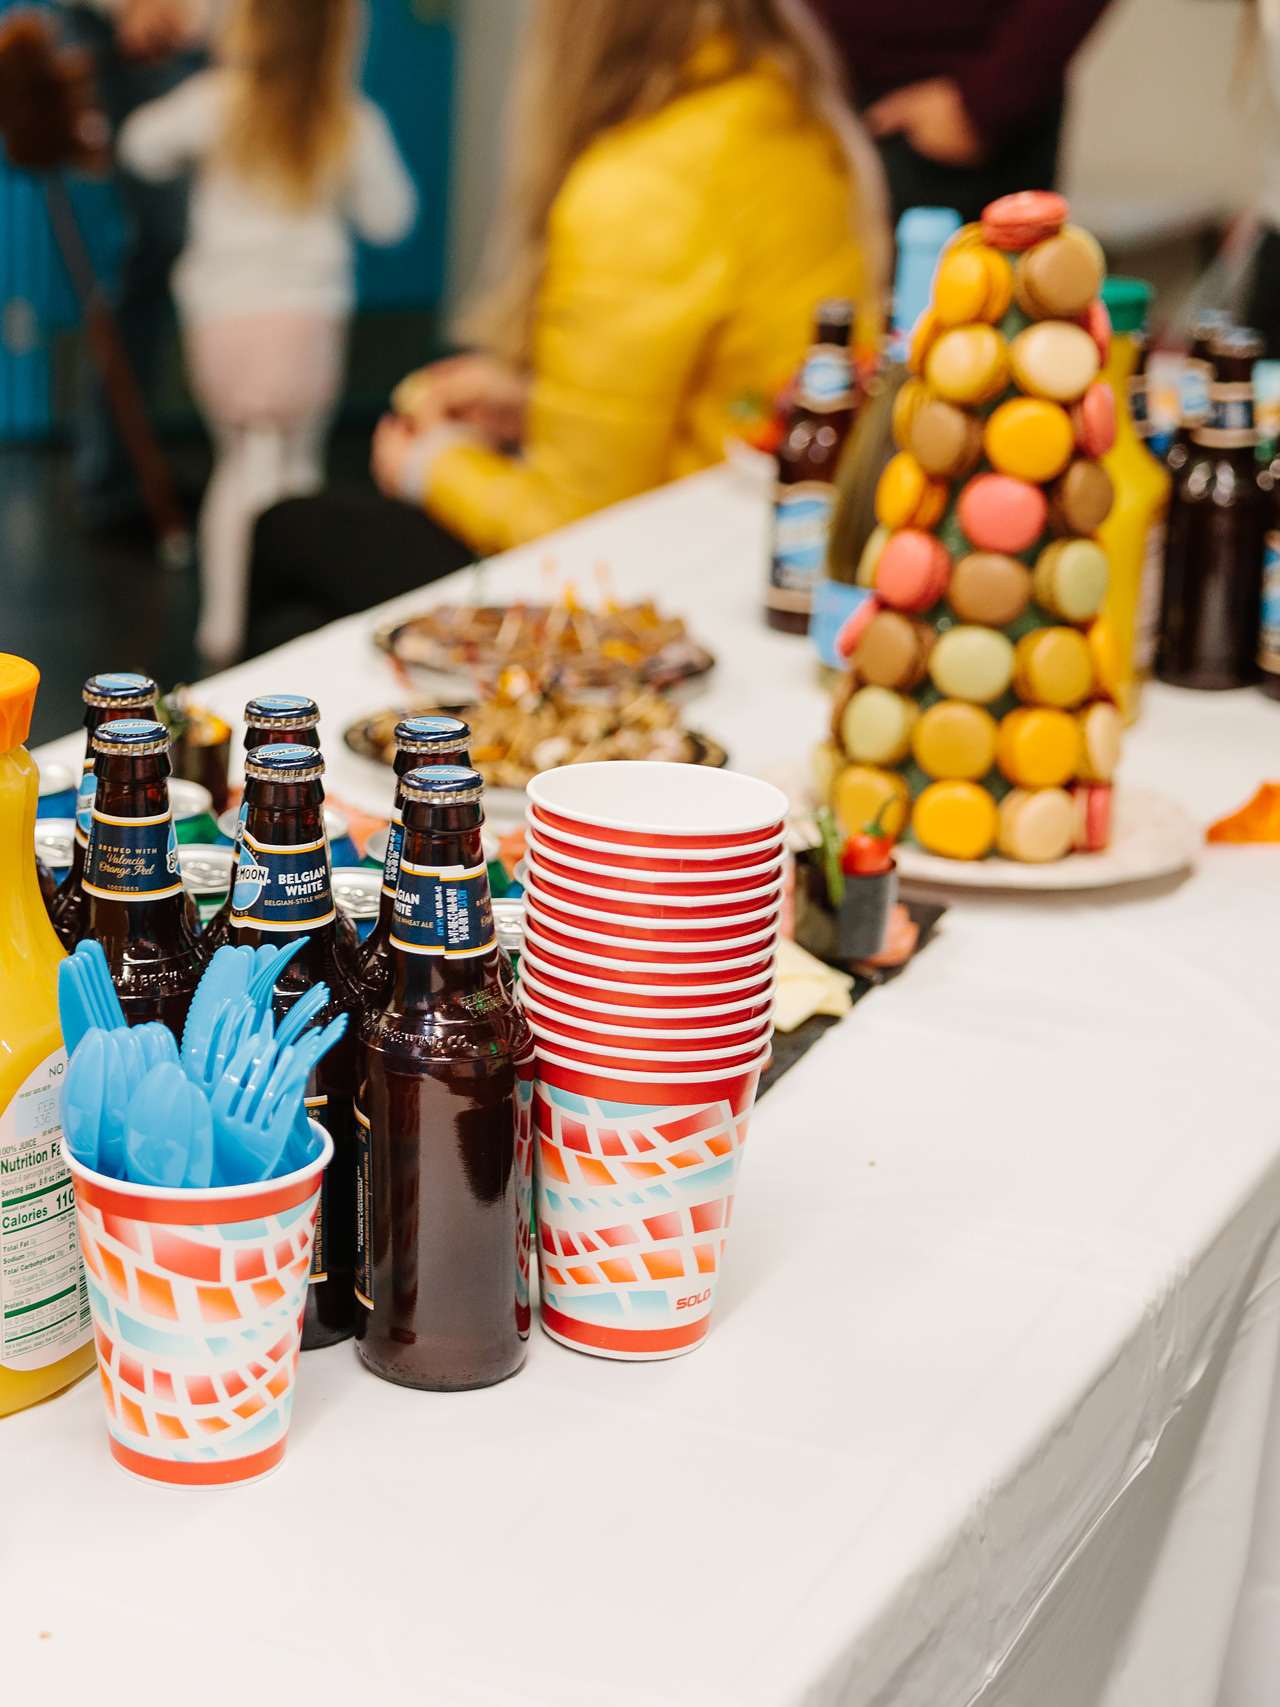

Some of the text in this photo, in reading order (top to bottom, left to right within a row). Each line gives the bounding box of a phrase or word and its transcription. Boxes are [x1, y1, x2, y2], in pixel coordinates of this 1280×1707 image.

[98, 844, 132, 854] BREWED
[106, 852, 146, 865] Valencia
[99, 861, 156, 878] Orange Peel
[240, 867, 267, 882] MOON
[278, 866, 326, 885] BELGIAN
[285, 880, 324, 896] WHITE
[264, 896, 313, 906] BELGIAN-STYLE
[396, 889, 420, 906] GIAN
[394, 900, 412, 916] HITE
[48, 1062, 64, 1078] NO
[19, 1138, 36, 1150] JUICE
[0, 1142, 61, 1174] Nutrition Fa
[2, 1186, 24, 1198] Serving
[25, 1182, 36, 1190] size
[2, 1188, 74, 1229] Calories 110
[3, 1244, 18, 1253] Total
[3, 1254, 26, 1264] Sodium
[4, 1266, 18, 1276] Total
[20, 1254, 56, 1271] Carbohydrate
[4, 1300, 24, 1310] Protein
[676, 1288, 712, 1310] SOLO
